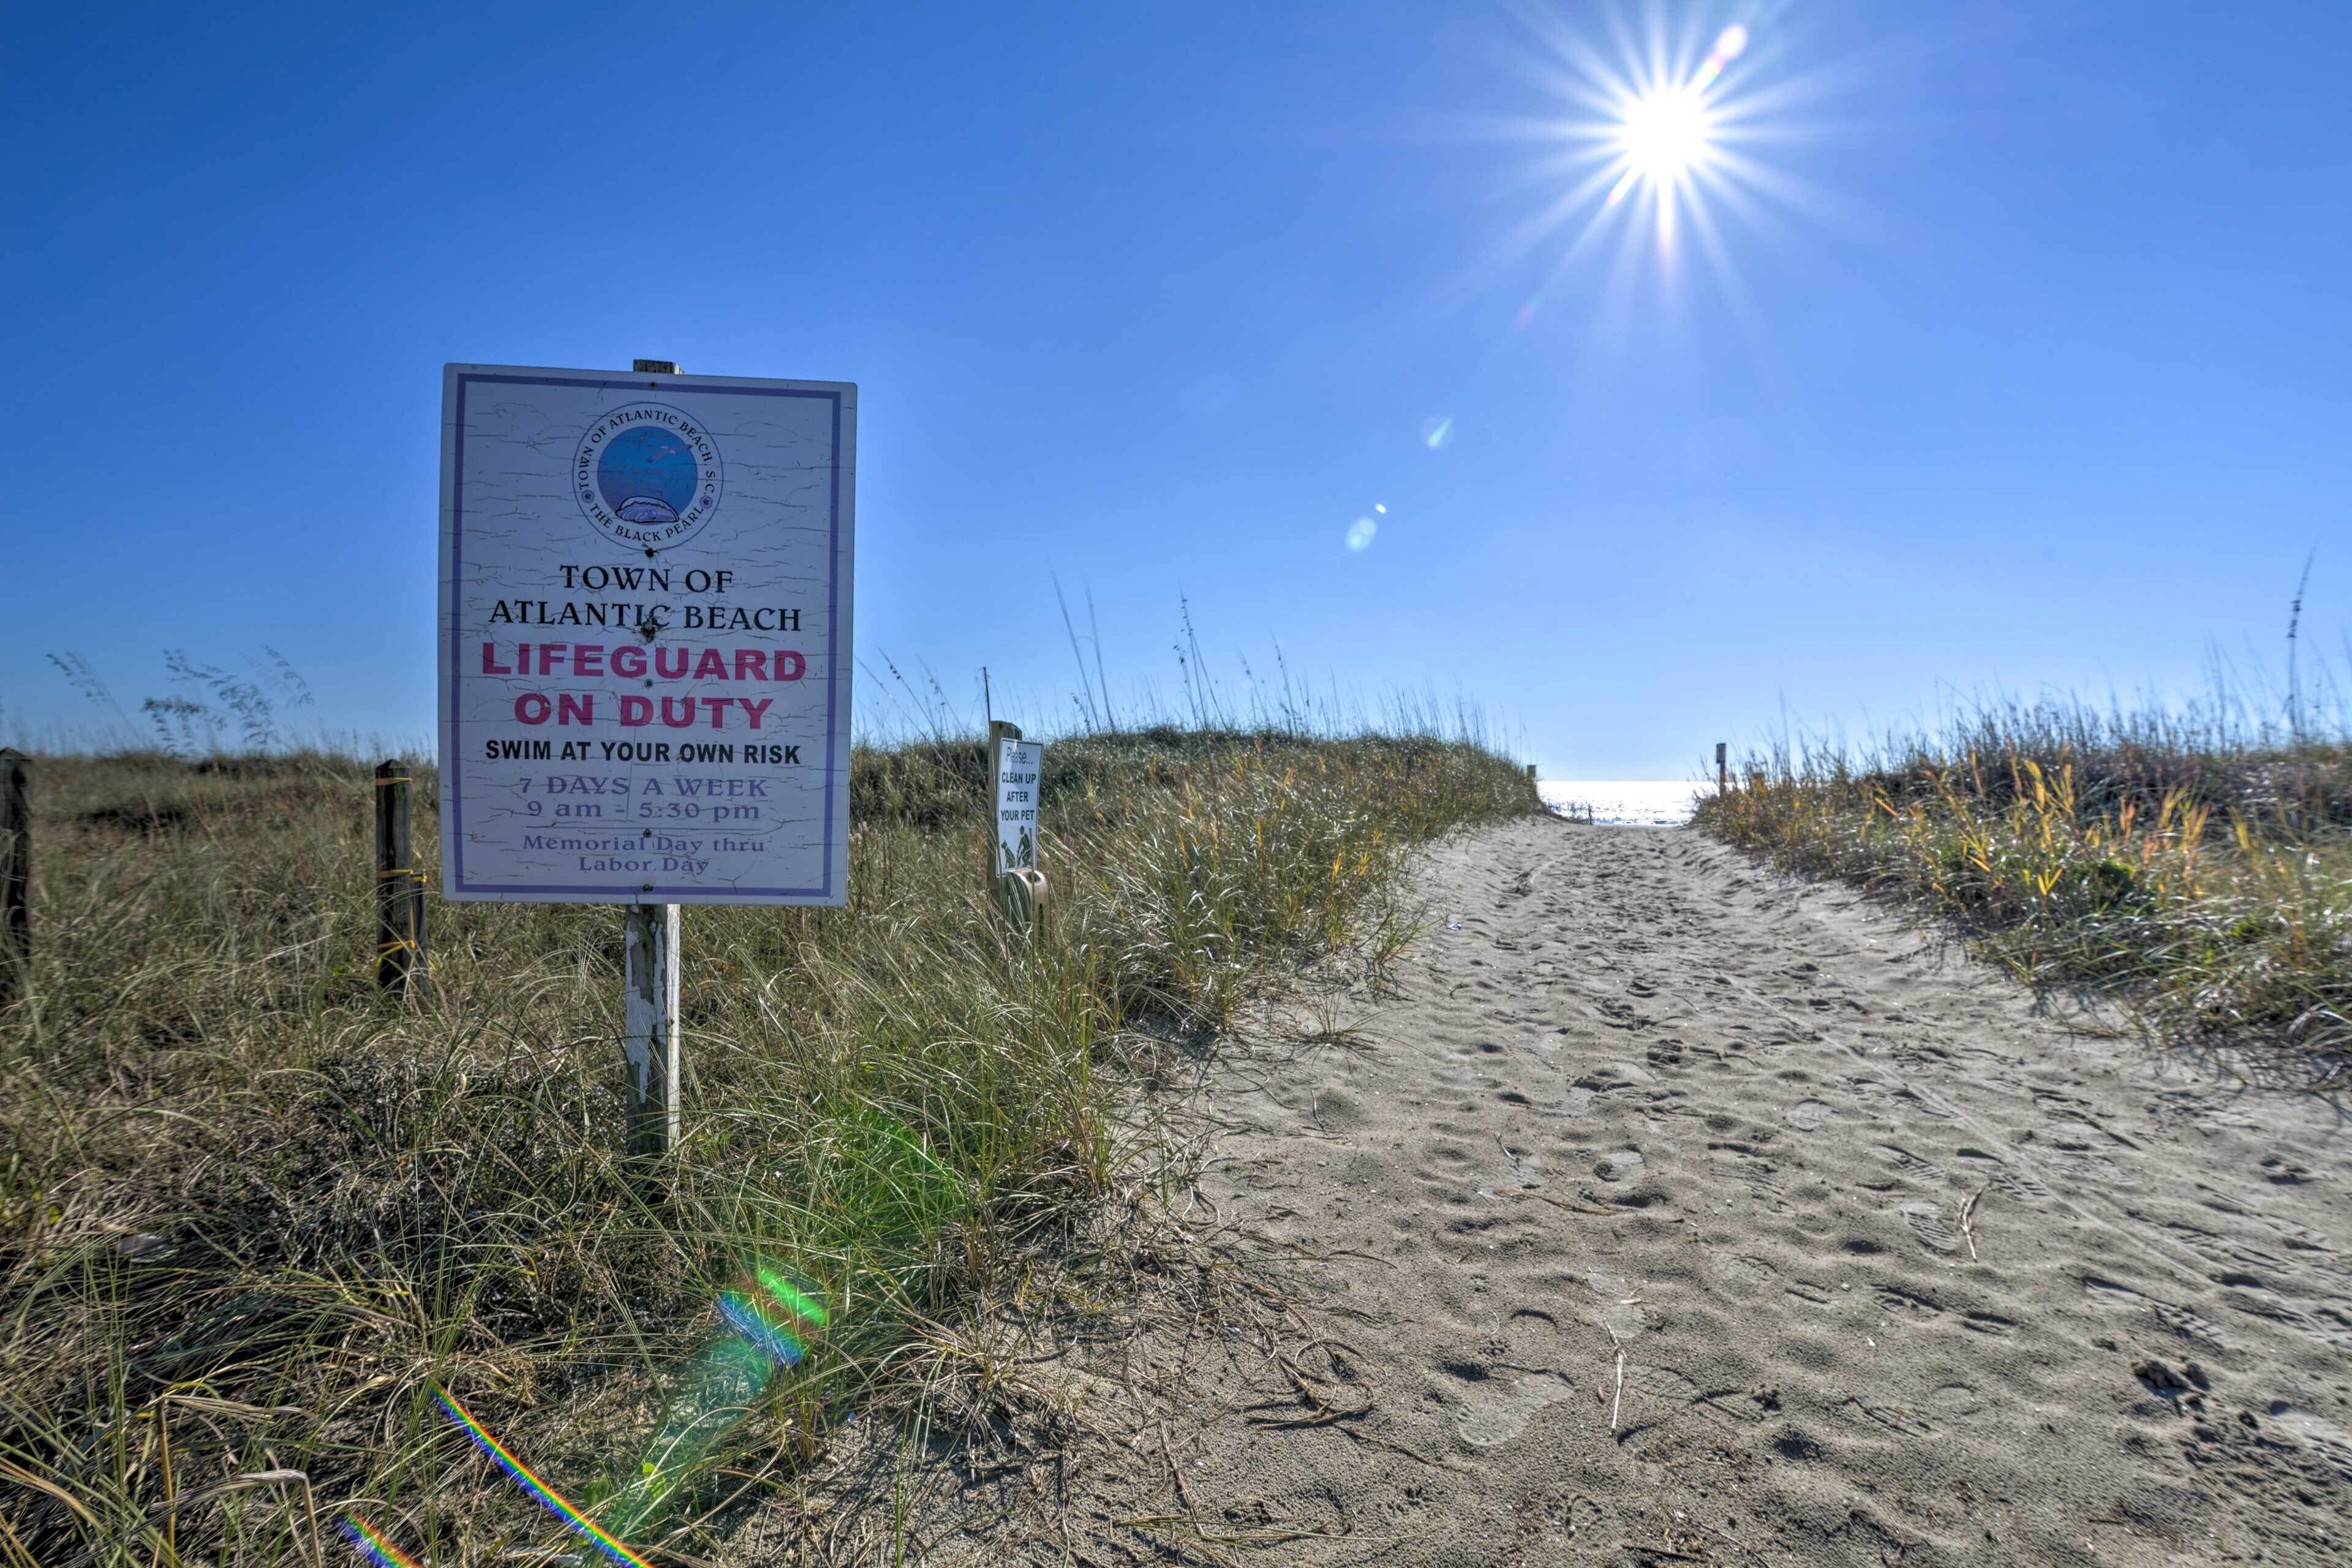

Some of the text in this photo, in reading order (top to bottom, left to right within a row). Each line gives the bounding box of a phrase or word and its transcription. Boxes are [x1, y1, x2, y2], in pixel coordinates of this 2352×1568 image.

[578, 446, 594, 491] TOWN
[591, 426, 607, 443] OF
[609, 410, 679, 429] ATLANTIC
[589, 503, 704, 542] THE BLACK PEARL
[559, 564, 734, 594] TOWN OF
[488, 600, 801, 631] ATLANTIC BEACH
[482, 641, 806, 682] LIFEGUARD
[514, 692, 774, 730] ON DUTY
[486, 739, 801, 765] SWIM AT YOUR OWN RISK
[519, 775, 769, 797] 7 DAYS A WEEK
[1001, 772, 1036, 784] CLEAN UP
[1006, 791, 1029, 802] AFTER
[527, 801, 543, 817] 9
[554, 804, 602, 818] am
[638, 802, 701, 819] 5:30
[713, 805, 760, 823] pm
[1001, 810, 1035, 821] YOUR PET
[522, 835, 764, 854] Memorial Day thru
[662, 857, 709, 875] Day
